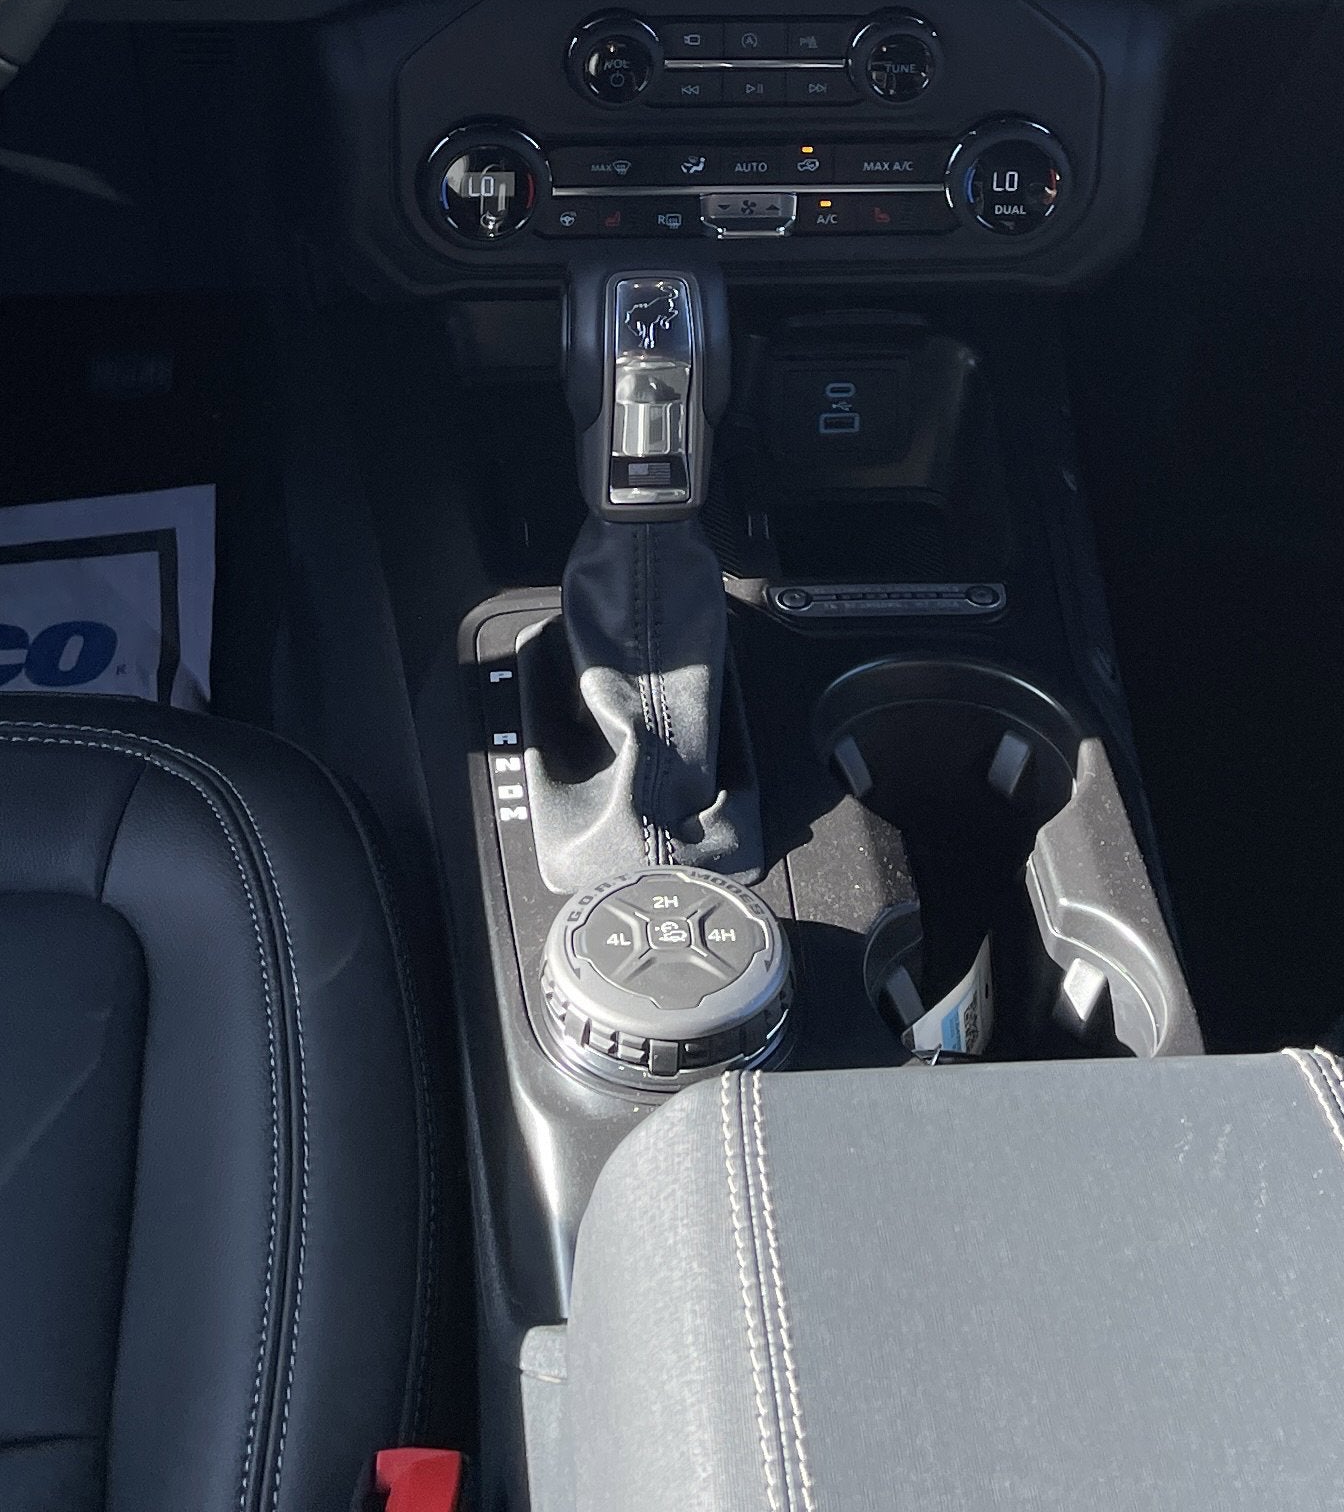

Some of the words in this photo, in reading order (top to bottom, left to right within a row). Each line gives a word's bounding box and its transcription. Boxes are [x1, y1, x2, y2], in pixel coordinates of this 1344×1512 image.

[884, 64, 917, 74] TUNE
[591, 164, 613, 172] MAX
[734, 162, 768, 173] AUTO
[862, 161, 890, 172] MAX
[892, 161, 914, 172] A/C
[468, 176, 495, 197] LO
[992, 171, 1018, 192] LO
[994, 204, 1027, 216] DUAL
[816, 214, 838, 225] A/C
[490, 670, 513, 683] P
[493, 732, 518, 746] R
[495, 757, 522, 772] N
[498, 785, 524, 800] D
[500, 806, 529, 822] M
[690, 870, 766, 916] MODES
[653, 895, 679, 910] 2H
[606, 933, 632, 947] 4L
[708, 929, 737, 942] 4H
